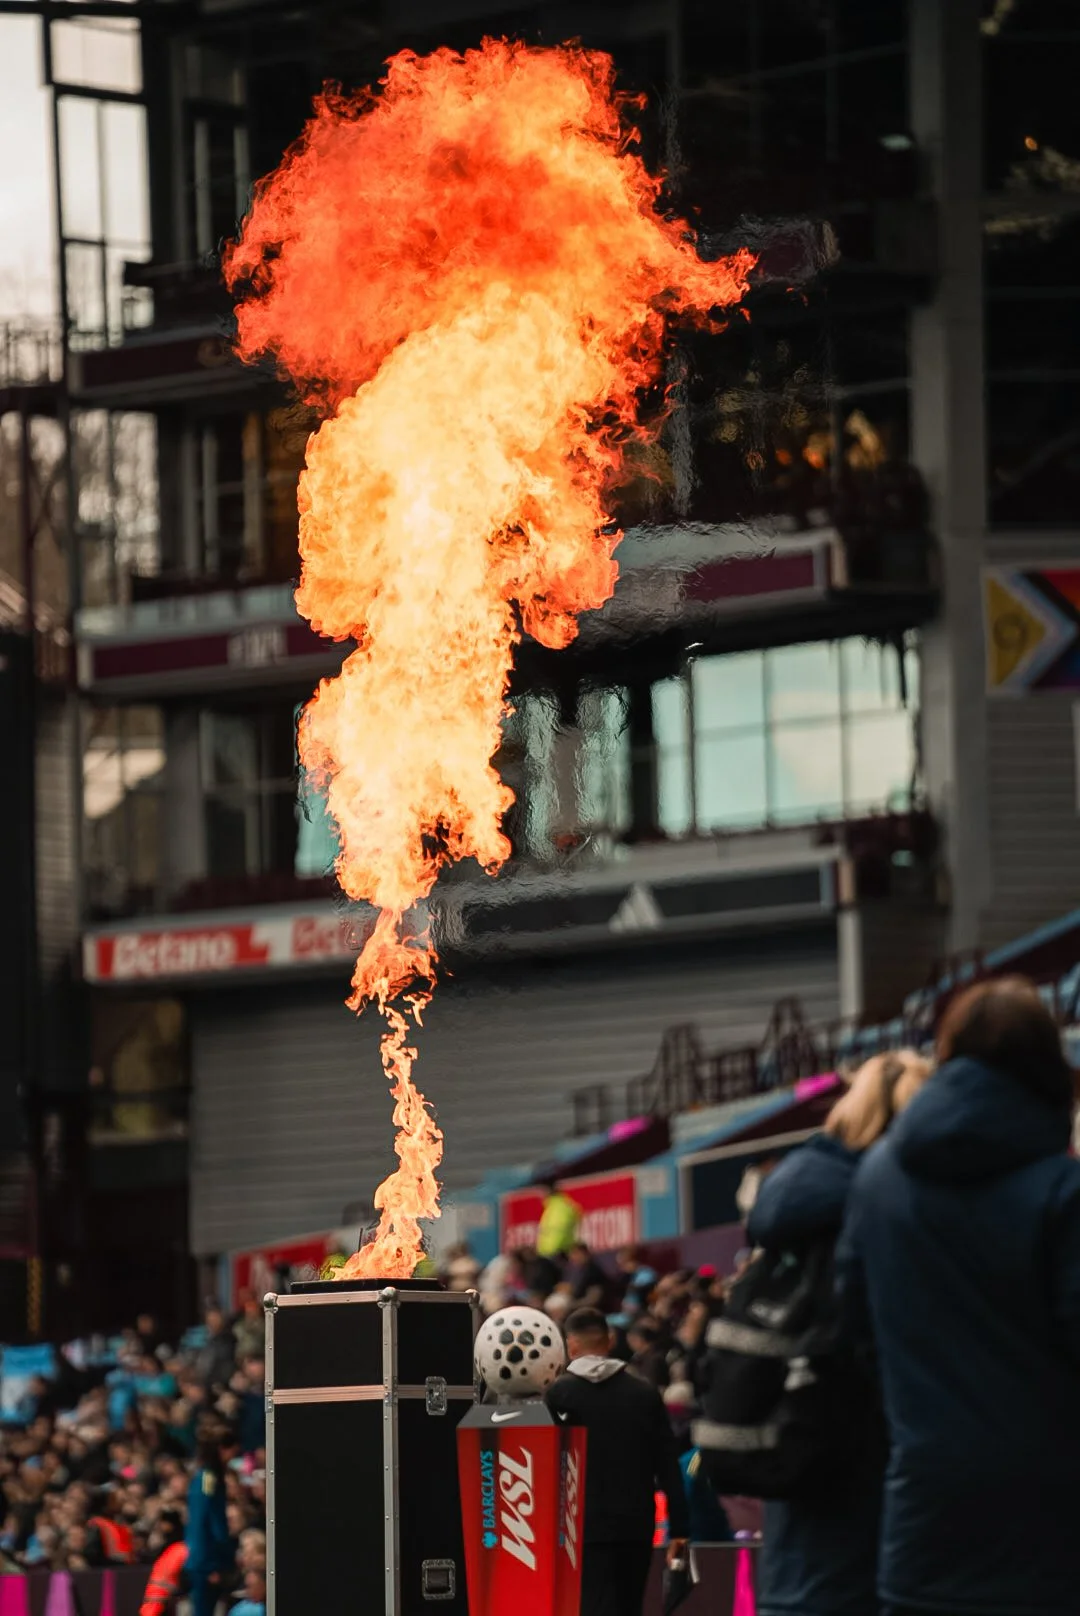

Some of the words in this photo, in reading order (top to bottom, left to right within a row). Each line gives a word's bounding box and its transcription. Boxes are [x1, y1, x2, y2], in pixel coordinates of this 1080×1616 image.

[112, 931, 237, 977] Betano
[481, 1451, 495, 1528] BARCLAYS
[498, 1446, 536, 1571] WSL
[566, 1450, 578, 1569] WSL
